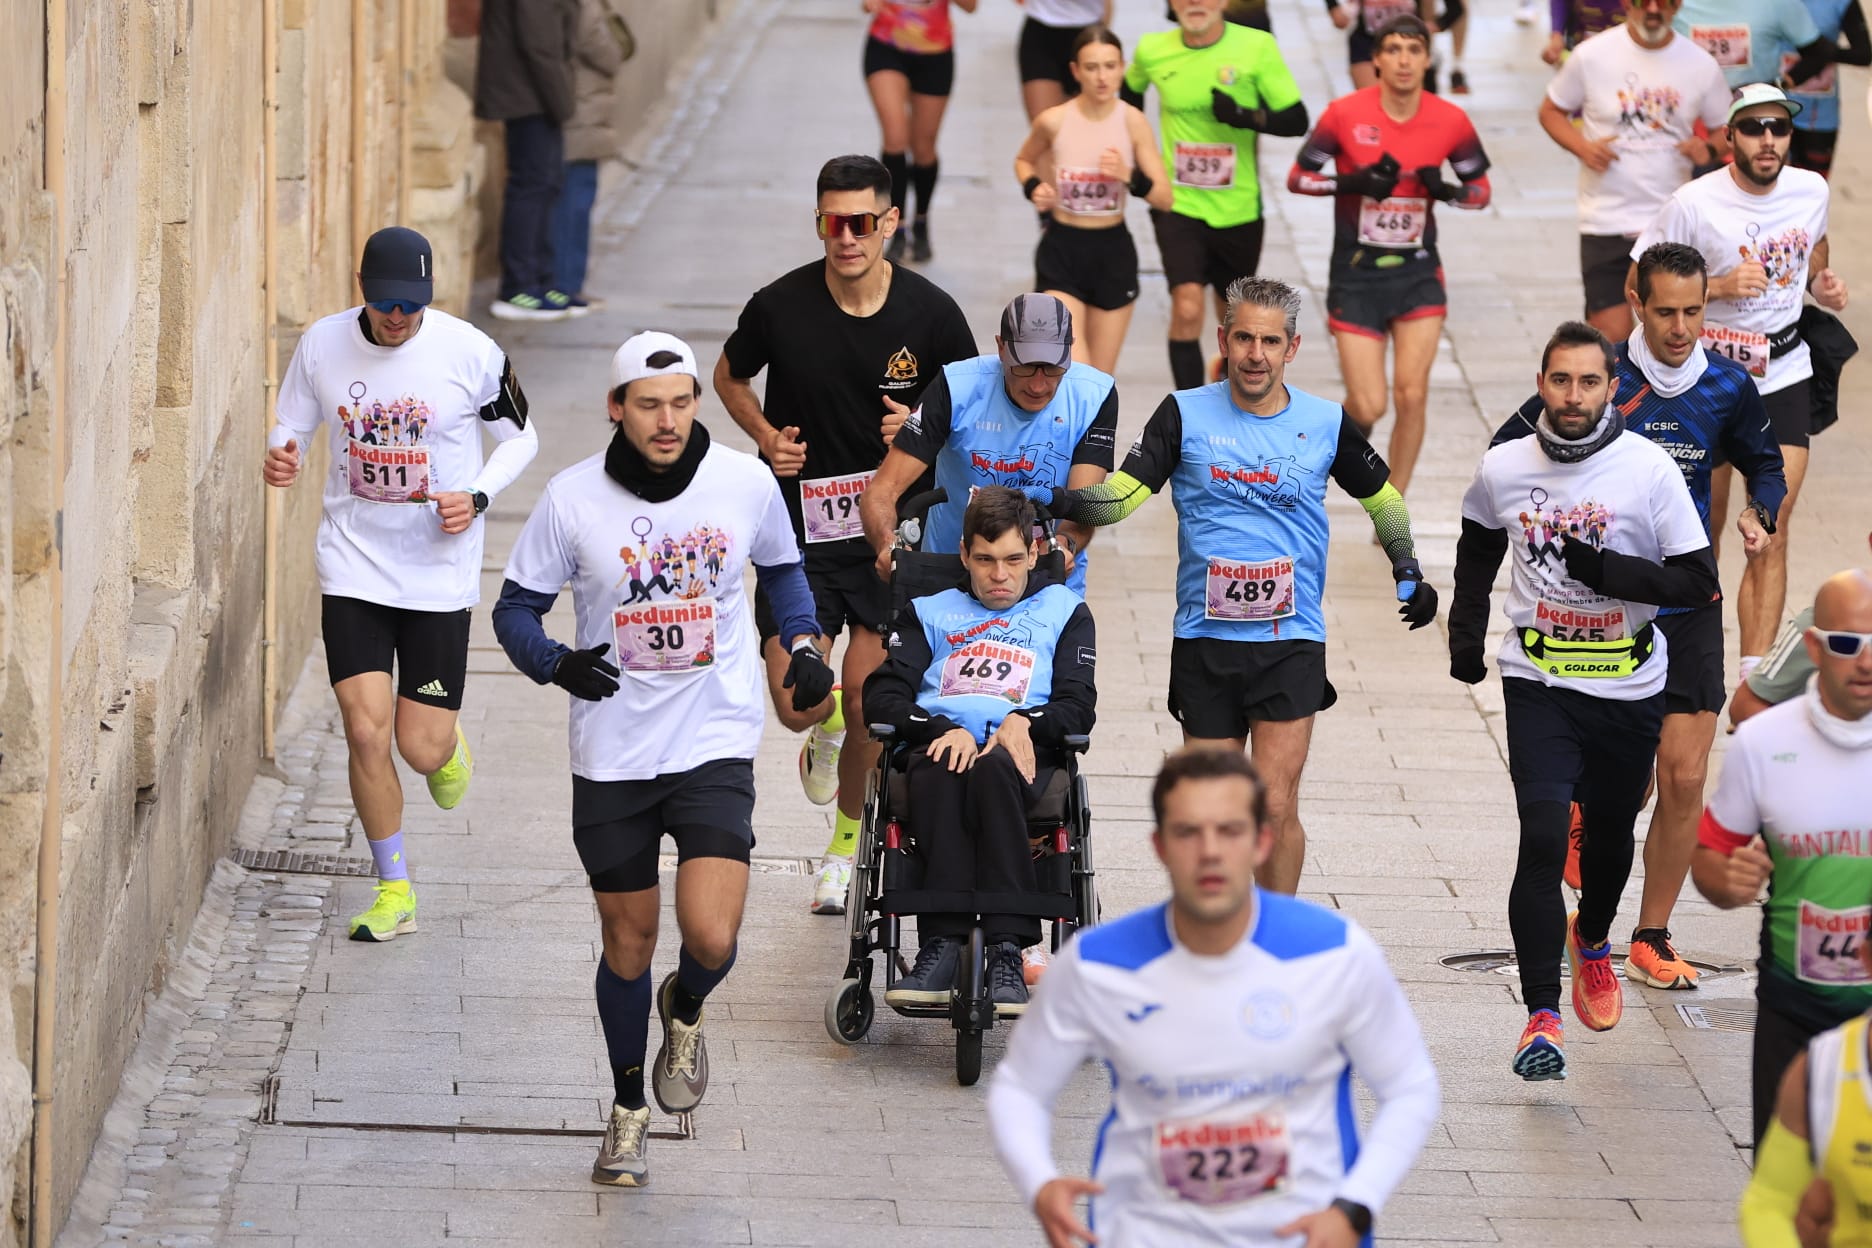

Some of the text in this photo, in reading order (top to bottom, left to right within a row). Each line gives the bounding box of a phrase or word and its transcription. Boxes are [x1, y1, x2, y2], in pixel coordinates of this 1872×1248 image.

[1186, 157, 1221, 173] 639
[1071, 183, 1107, 199] 640
[1376, 212, 1412, 230] 468
[1711, 342, 1751, 362] 615
[1652, 422, 1679, 431] CSIC
[350, 441, 427, 465] bedunia
[362, 462, 407, 487] 511
[802, 475, 872, 499] beduni
[1209, 561, 1292, 580] bedunia
[1226, 579, 1277, 602] 489
[614, 603, 713, 628] bedunia
[1537, 601, 1624, 628] bedunia
[647, 624, 684, 650] 30
[1552, 625, 1605, 642] 565
[949, 642, 1032, 669] bedunia
[959, 658, 1012, 681] 469
[1564, 664, 1620, 672] GOLDCAR
[417, 687, 448, 697] adidas
[1817, 934, 1858, 961] 44
[1187, 1145, 1260, 1181] 222
